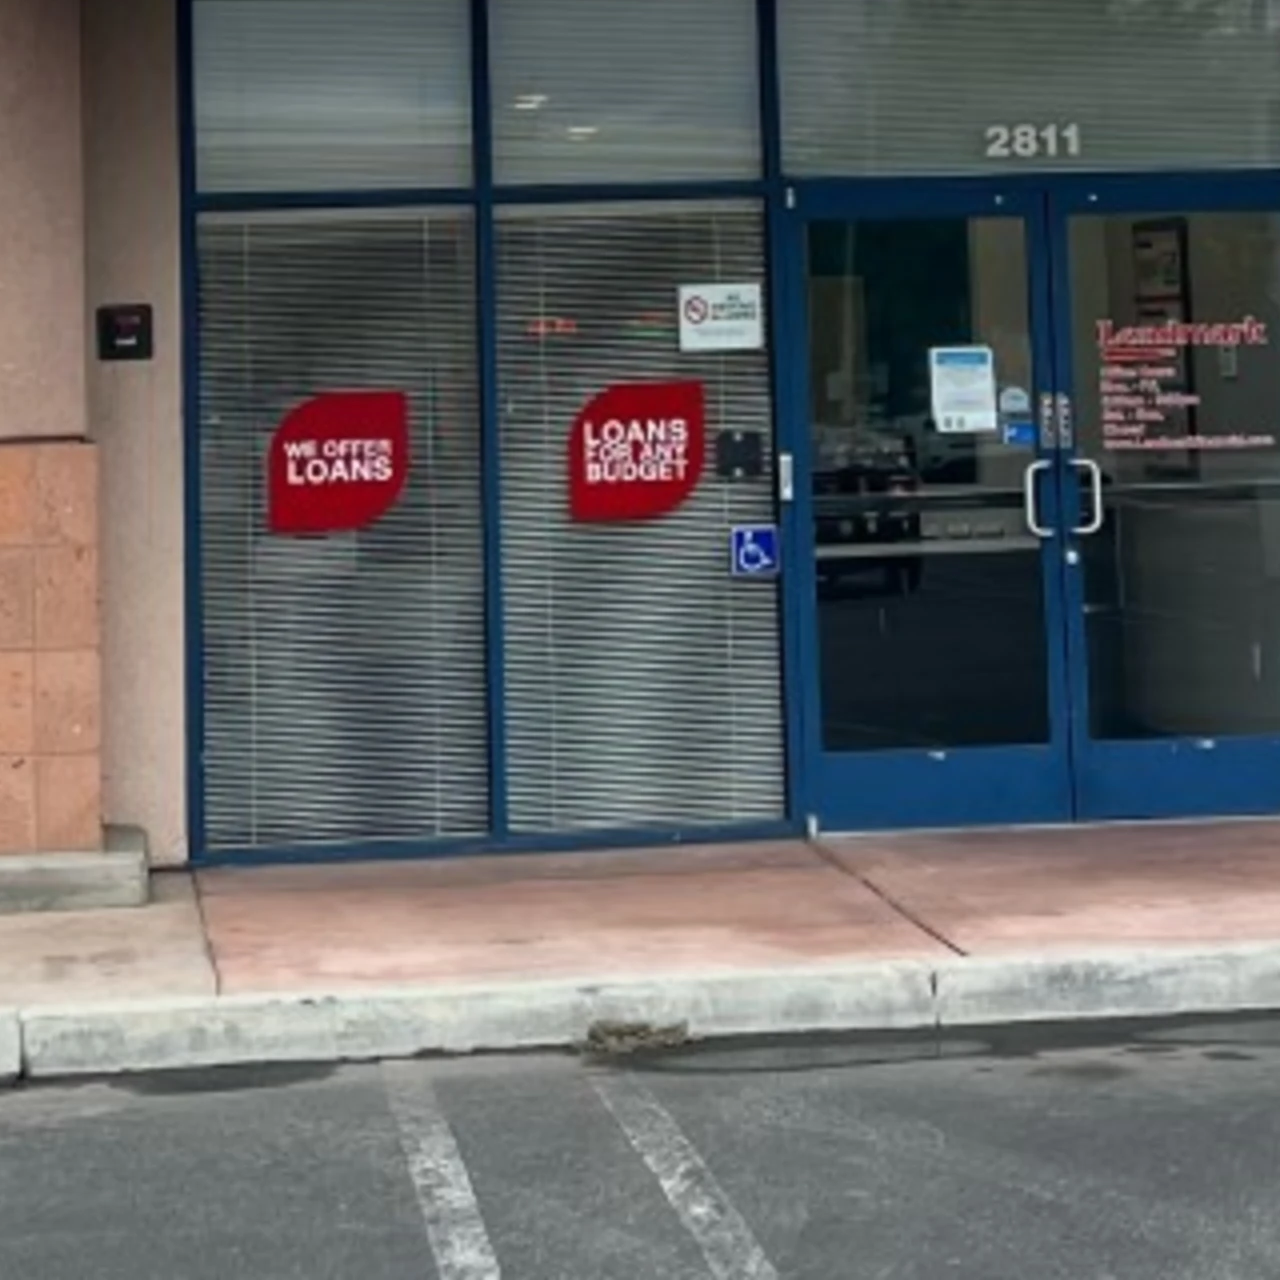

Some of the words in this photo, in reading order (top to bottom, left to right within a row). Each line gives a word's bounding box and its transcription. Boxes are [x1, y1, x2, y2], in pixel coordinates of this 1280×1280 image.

[985, 123, 1080, 157] 2811
[1096, 317, 1268, 345] Lendmark
[583, 418, 689, 447] LOANS
[287, 457, 394, 486] LOANS
[586, 459, 689, 484] BUDGET
